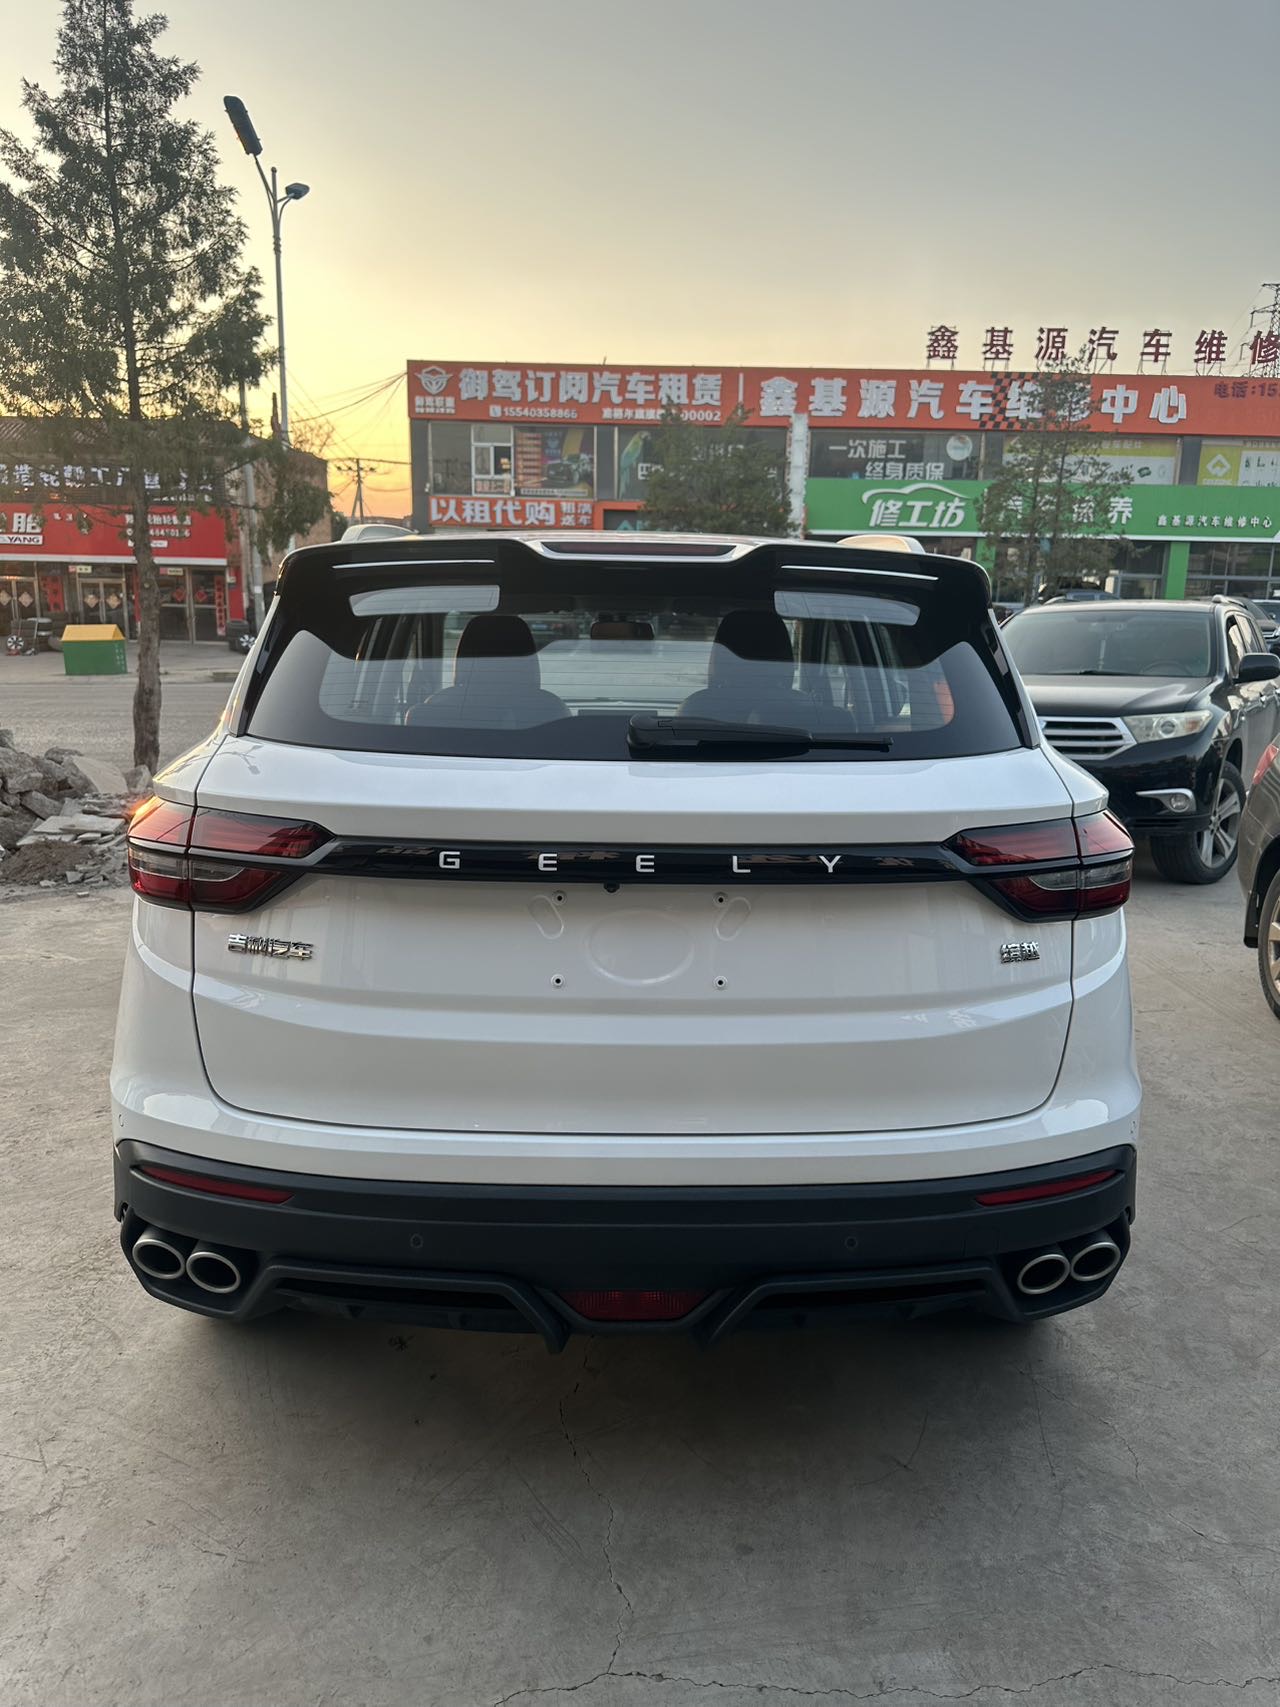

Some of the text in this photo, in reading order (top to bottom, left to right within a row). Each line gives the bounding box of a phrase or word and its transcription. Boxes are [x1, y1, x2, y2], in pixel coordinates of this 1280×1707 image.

[926, 325, 1280, 364] 鑫基源汽车维修
[458, 367, 722, 406] 御驾订阅汽车租赁
[829, 439, 907, 459] 一次施工
[865, 462, 945, 480] 终身质保
[429, 499, 556, 526] 以租代购
[869, 497, 966, 528] 修工坊
[438, 851, 844, 874] GEELY
